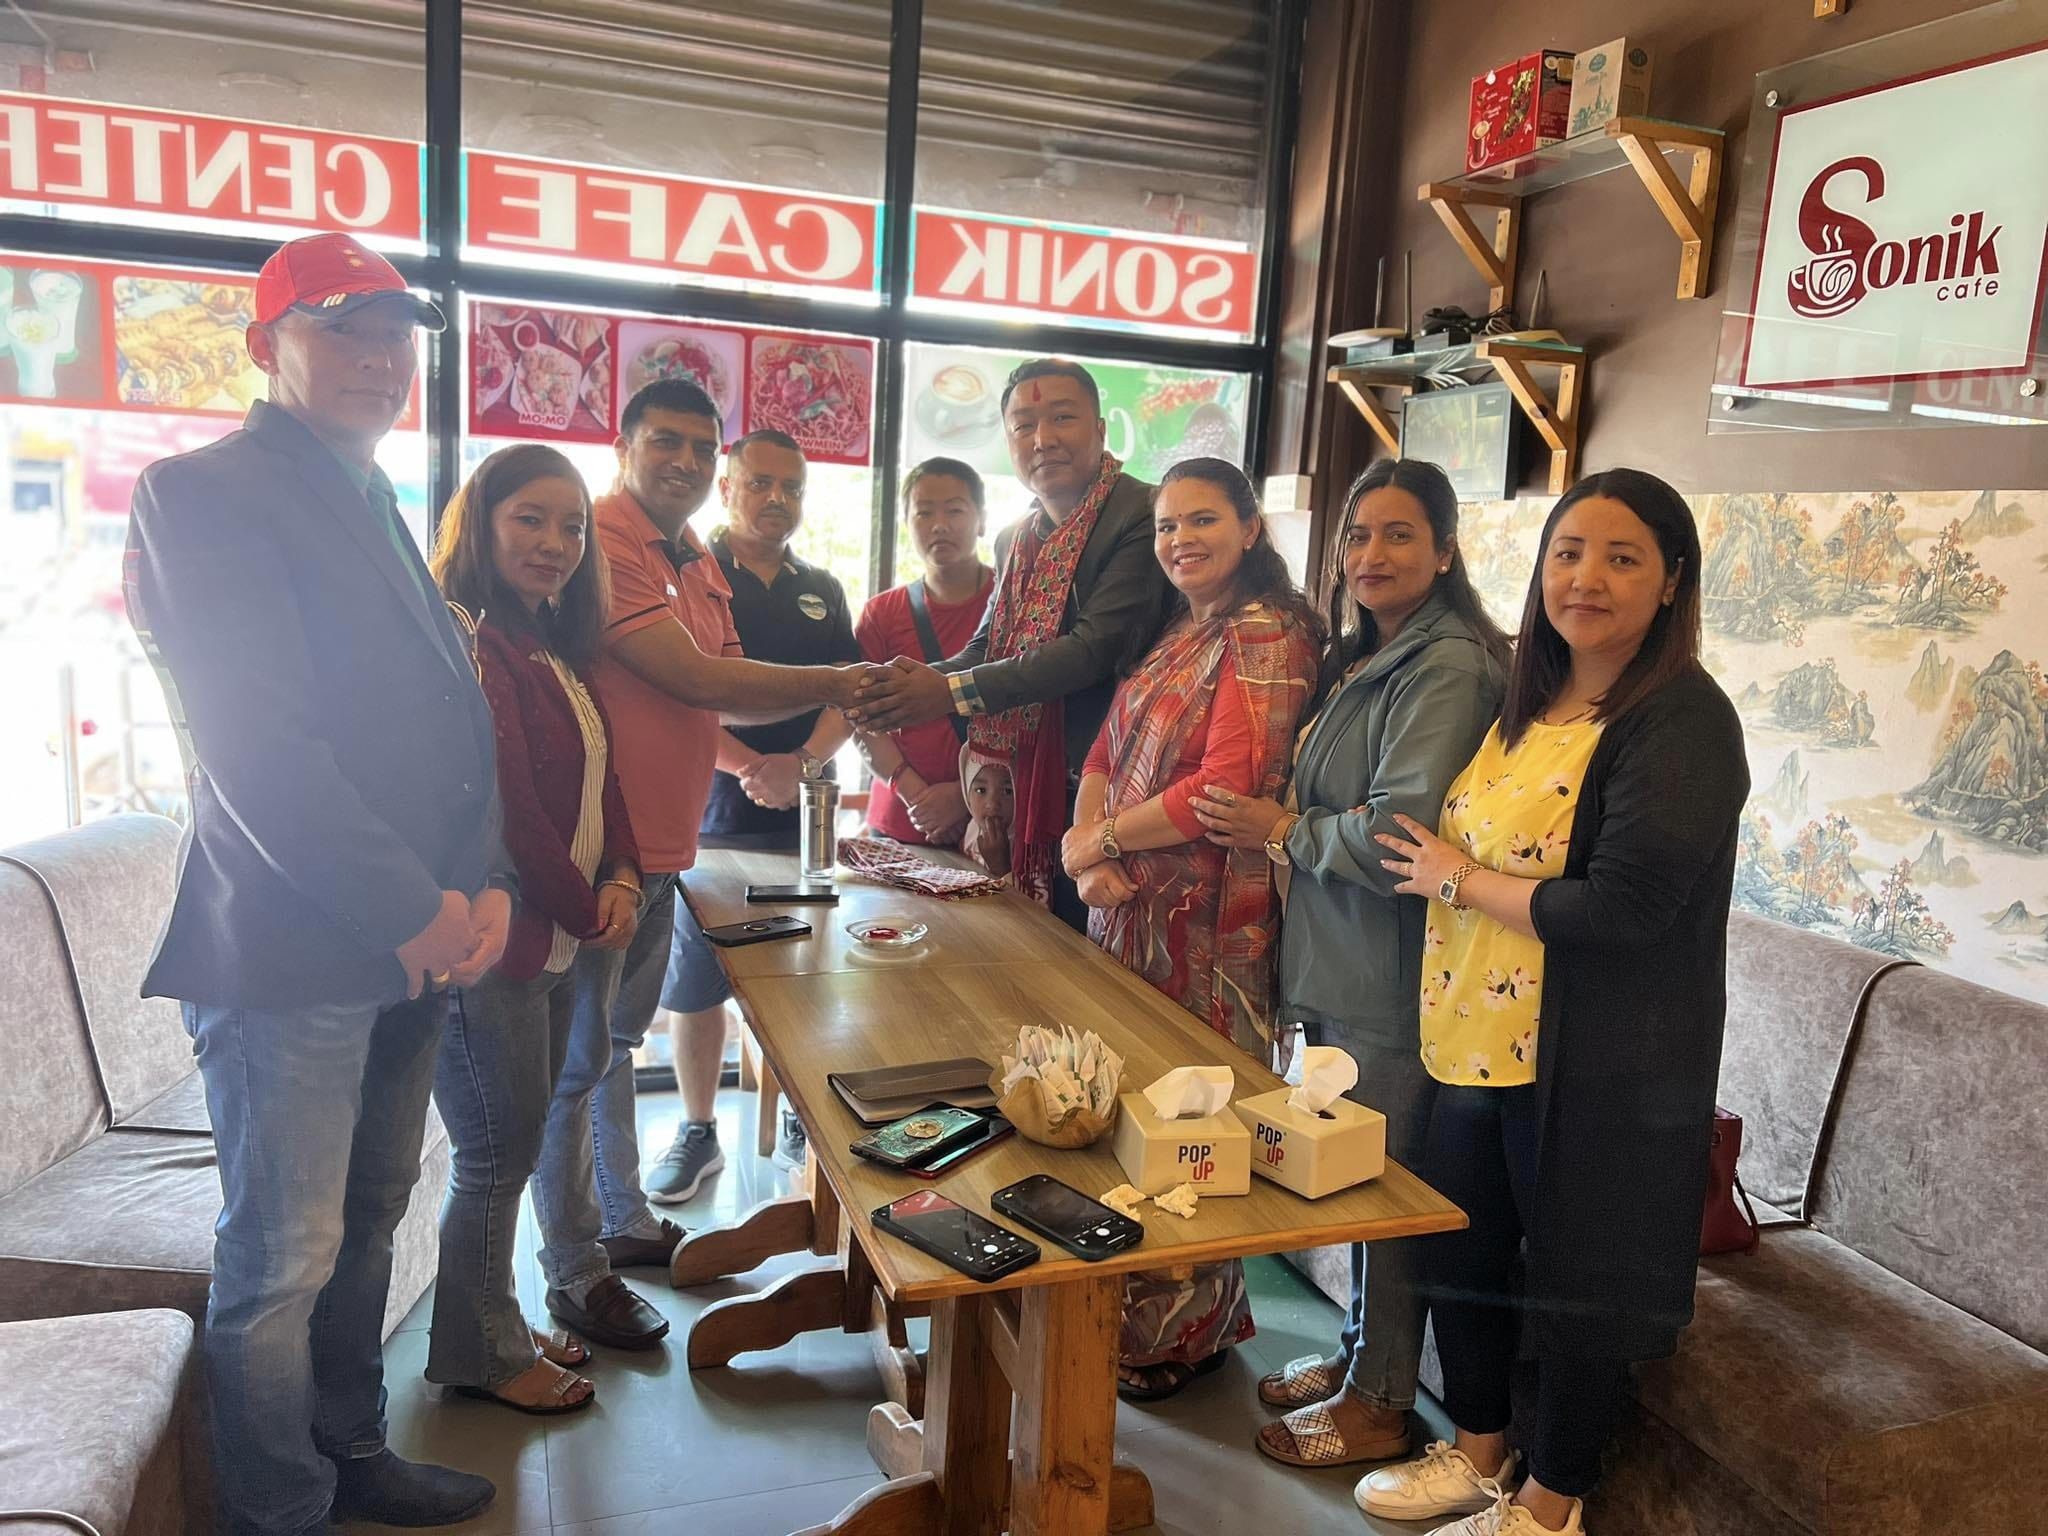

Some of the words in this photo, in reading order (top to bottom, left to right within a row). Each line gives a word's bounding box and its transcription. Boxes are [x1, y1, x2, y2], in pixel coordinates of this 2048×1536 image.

[1787, 155, 2003, 319] Sonik
[1936, 278, 1999, 302] cafe
[1256, 1121, 1283, 1146] POP
[1178, 1144, 1211, 1164] POP
[1266, 1146, 1285, 1167] UP
[1192, 1160, 1215, 1180] UP
